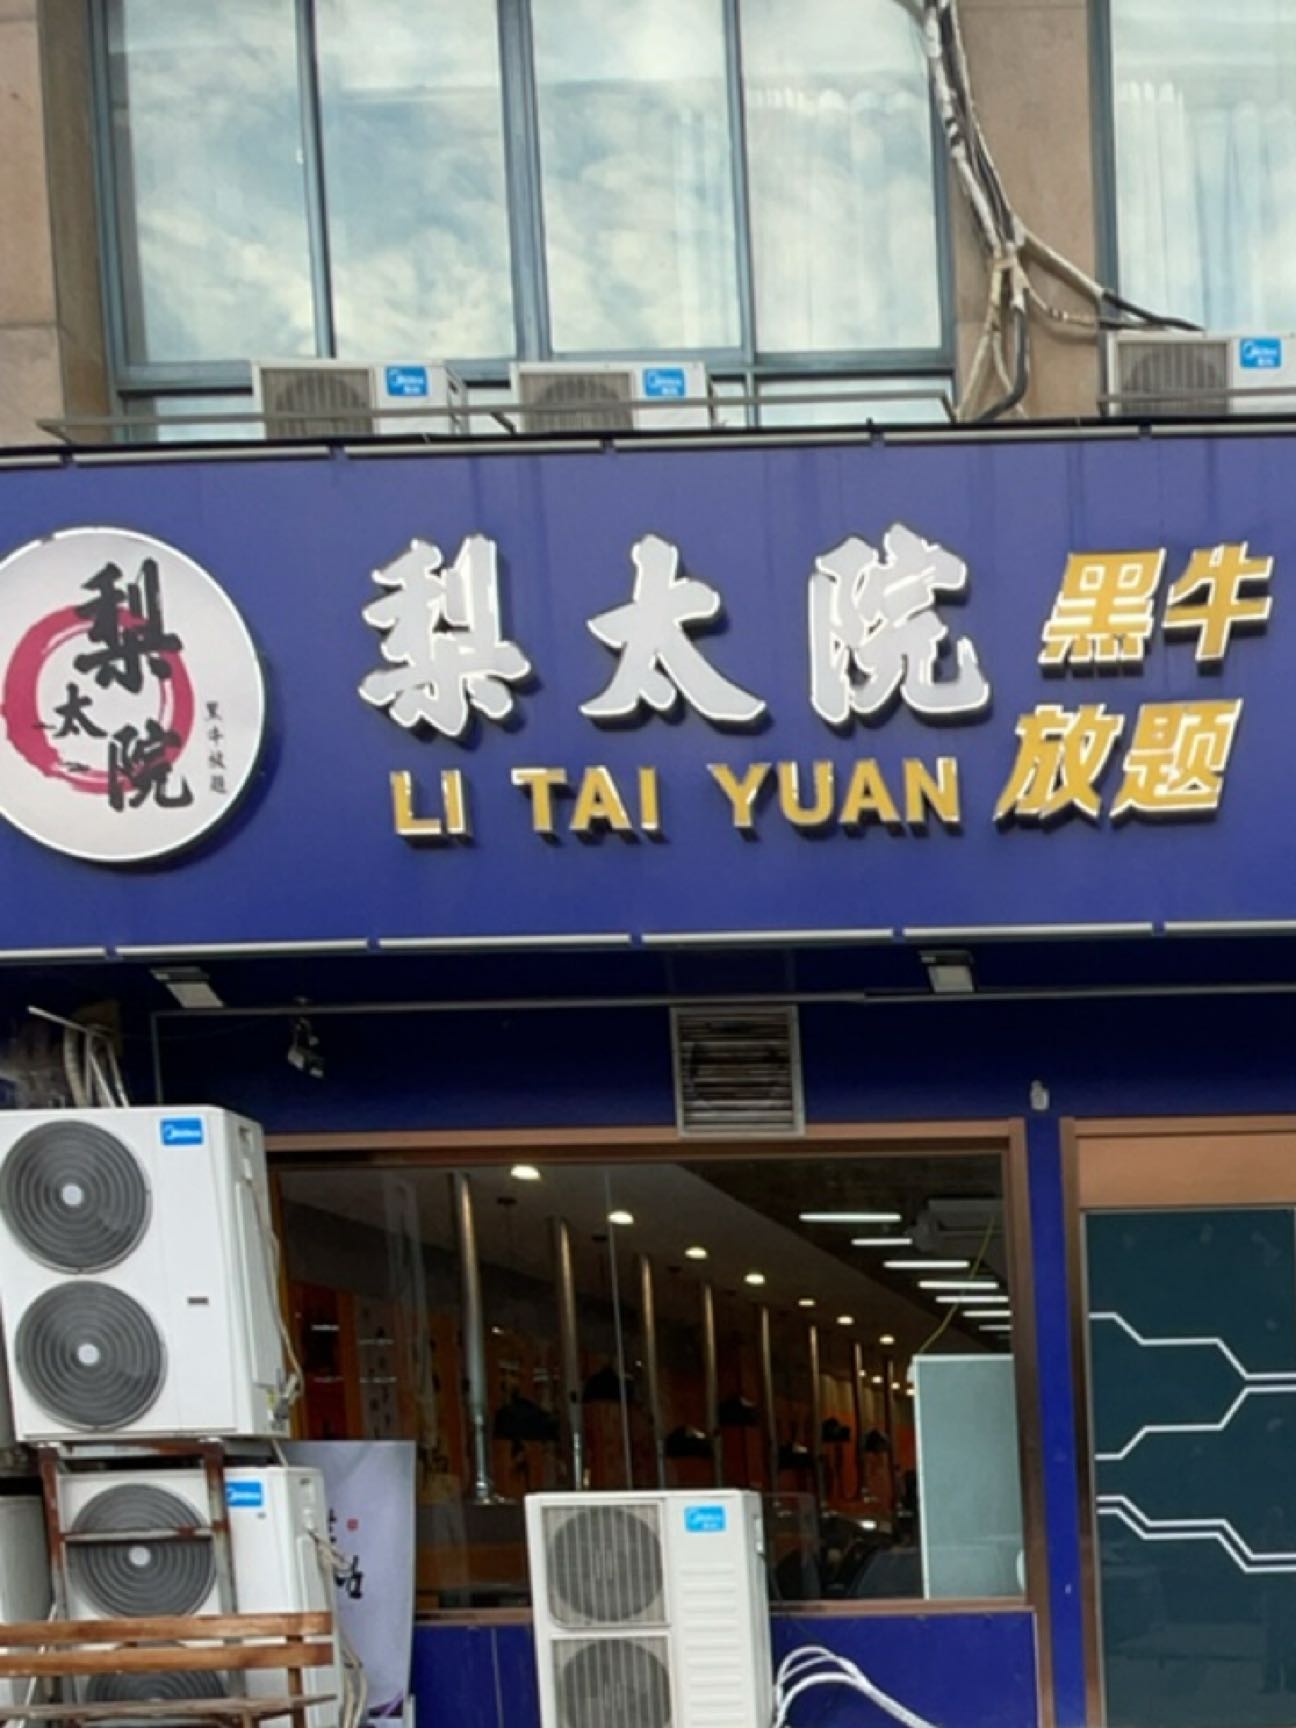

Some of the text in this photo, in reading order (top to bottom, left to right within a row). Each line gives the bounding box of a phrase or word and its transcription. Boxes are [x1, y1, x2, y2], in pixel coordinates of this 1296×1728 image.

[358, 523, 989, 737] 梨太院
[1037, 541, 1274, 664] 黑牛
[389, 757, 962, 836] LI TAI YUAN
[992, 698, 1244, 822] 放题
